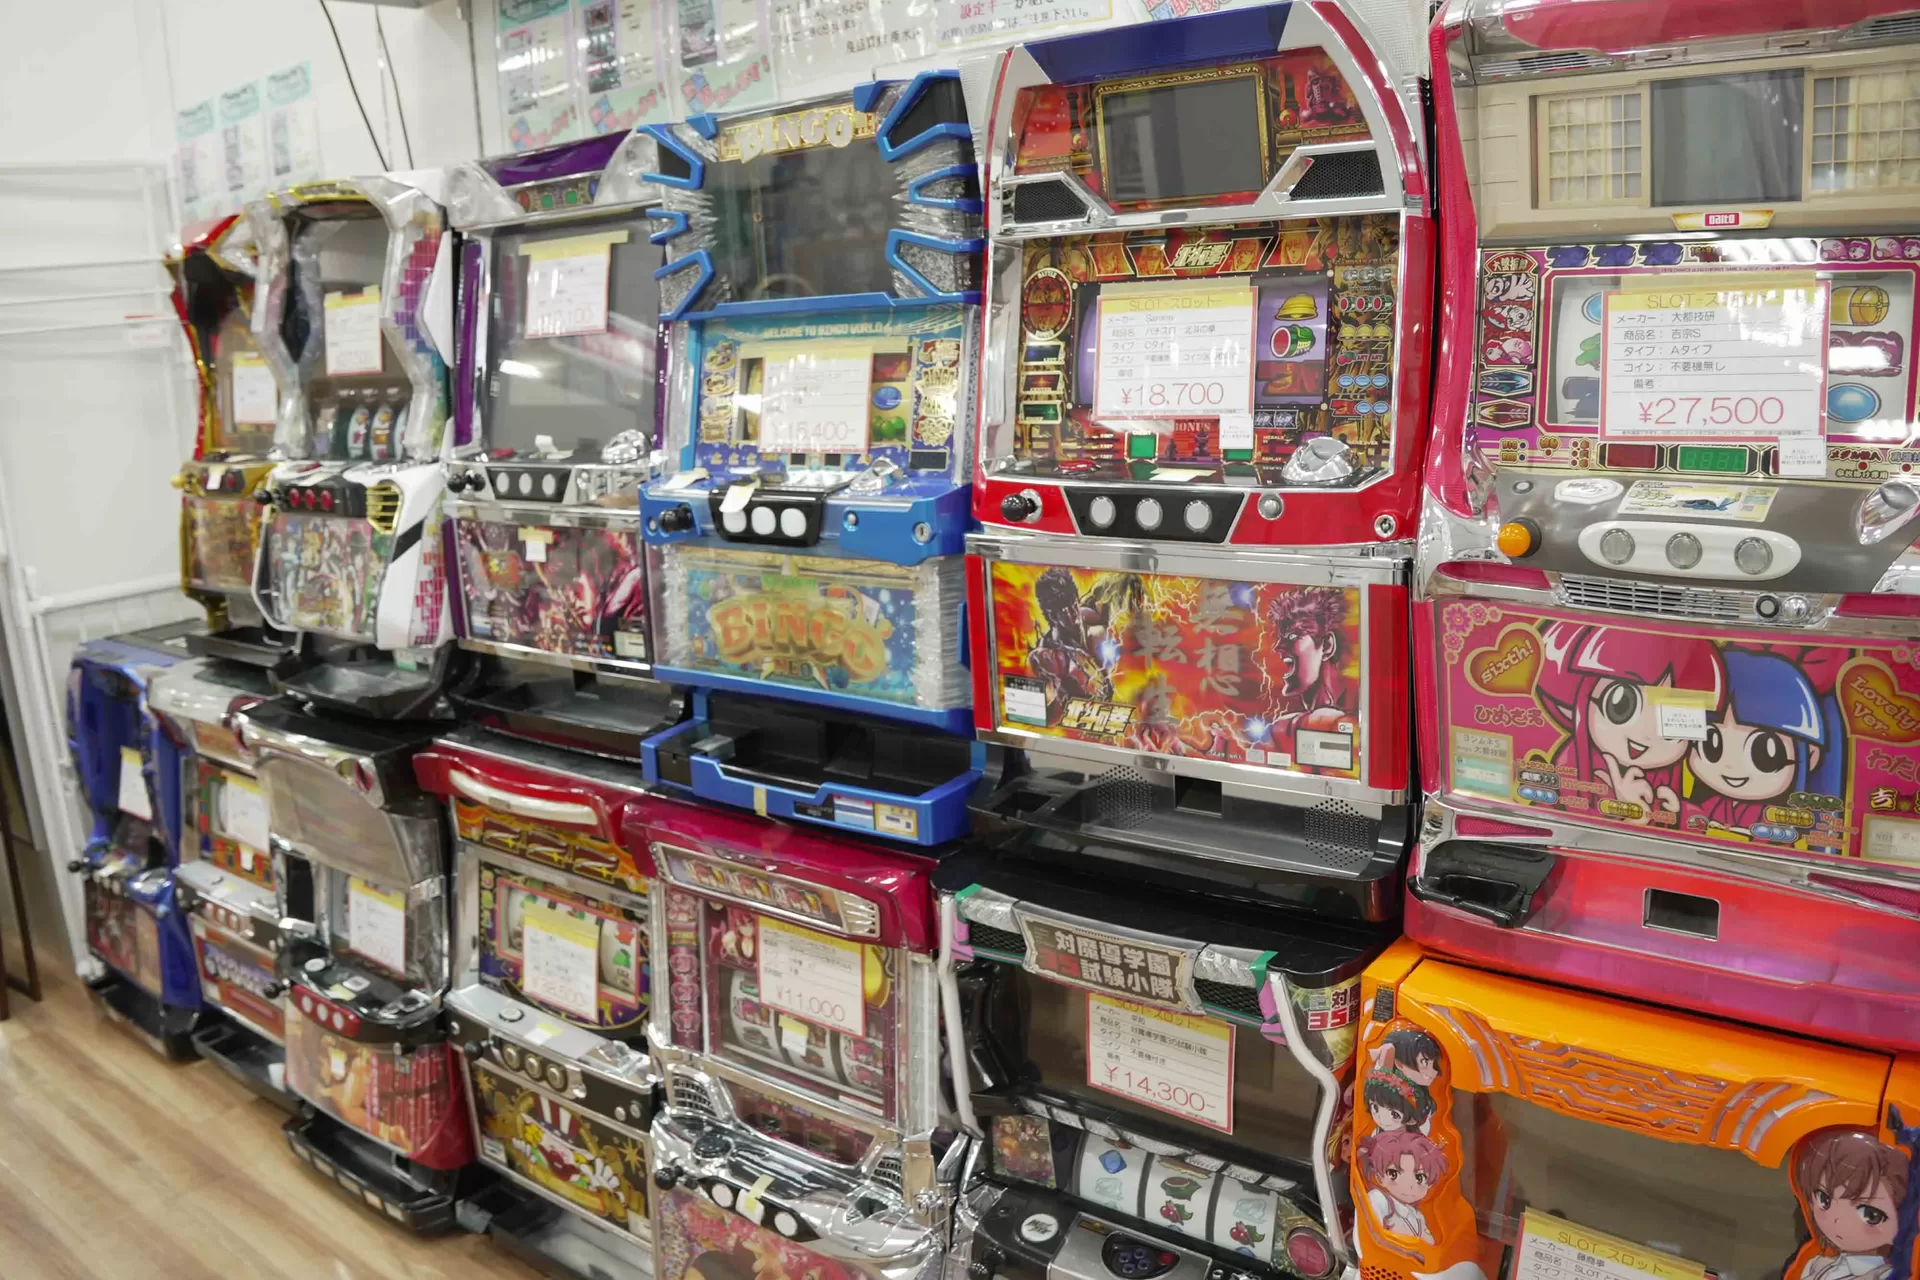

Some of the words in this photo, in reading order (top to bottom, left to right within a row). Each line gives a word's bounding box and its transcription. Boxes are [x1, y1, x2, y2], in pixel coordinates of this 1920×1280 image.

[736, 111, 853, 164] BINGO
[1671, 311, 1715, 322] 大都技研
[804, 327, 817, 335] TO
[850, 323, 883, 334] WORLD
[1671, 329, 1701, 339] 吉宗S
[1670, 344, 1713, 355] Aタイプ
[1670, 361, 1726, 373] 不要機無し
[1121, 382, 1224, 406] ¥18,700
[1638, 396, 1784, 427] ¥27,500
[711, 600, 887, 683] BINGO
[1481, 639, 1534, 684] sixth!
[1061, 699, 1136, 735] 北斗の拳
[1853, 702, 1891, 736] Ver.
[1054, 930, 1172, 977] 対魔導学園
[1039, 947, 1175, 999] 35試験小隊
[1130, 1038, 1142, 1047] AT
[1574, 1264, 1601, 1279] SLOT
[1576, 1251, 1606, 1268] 藤商事
